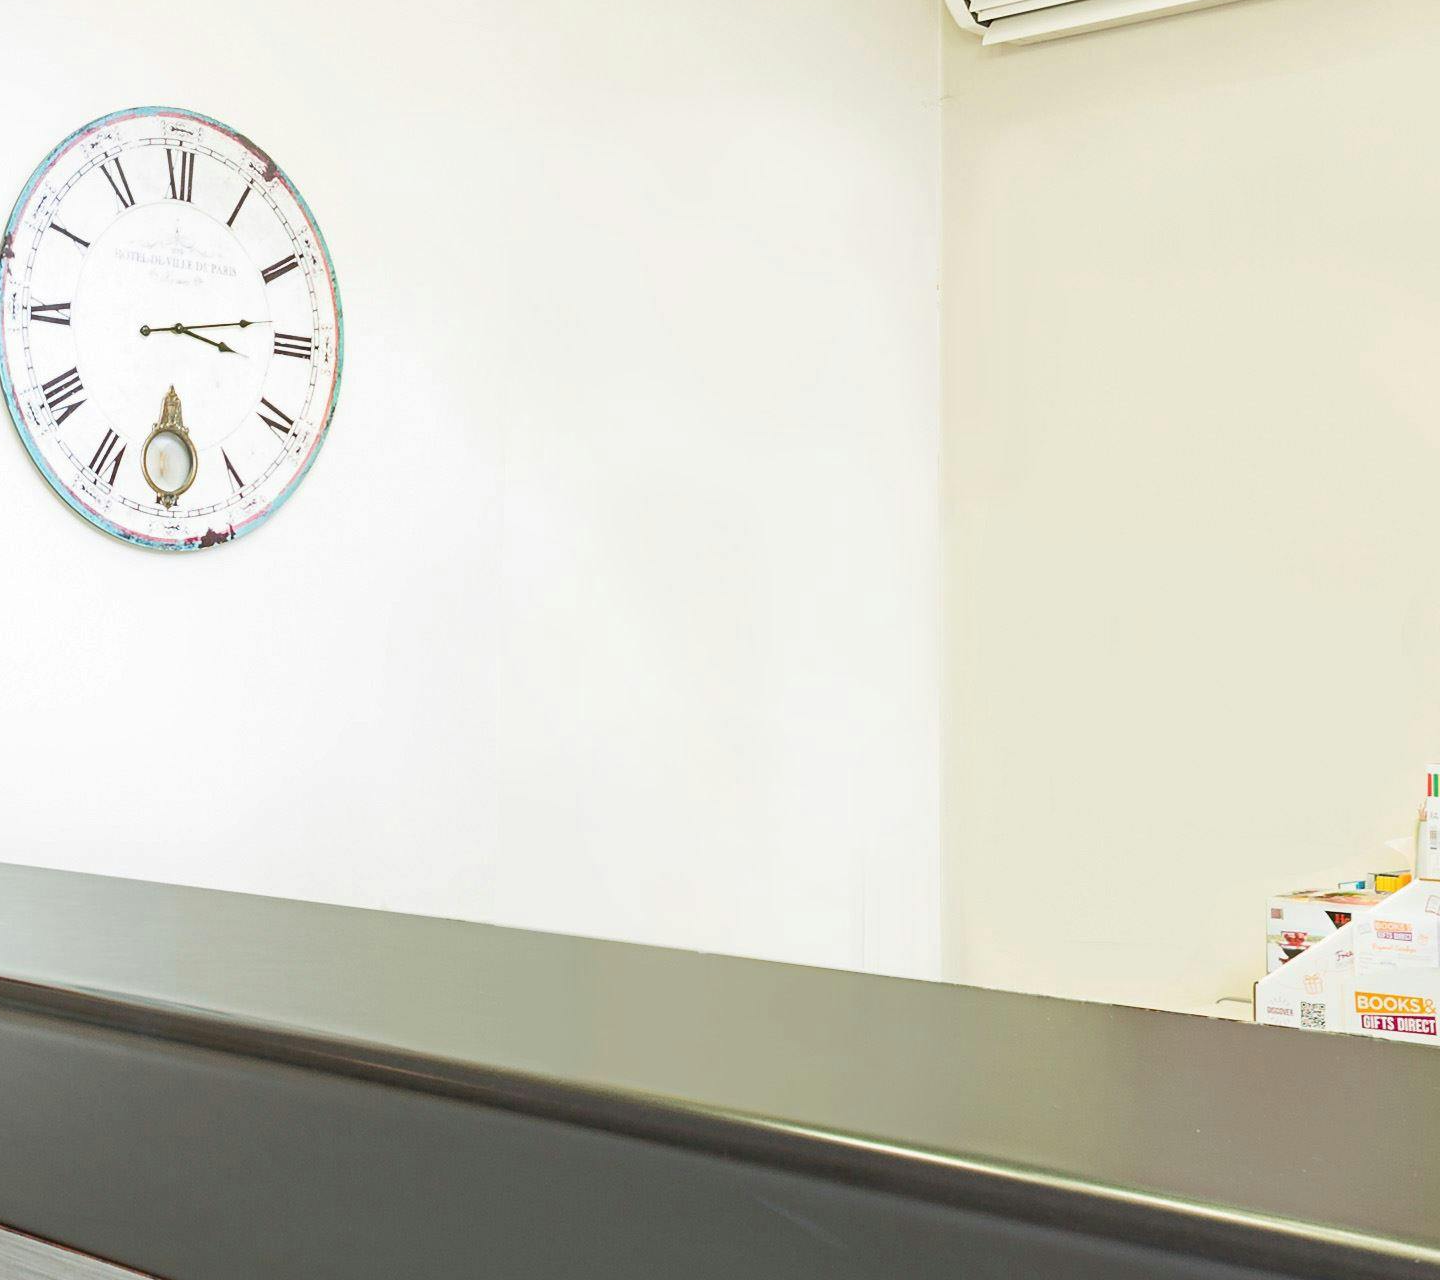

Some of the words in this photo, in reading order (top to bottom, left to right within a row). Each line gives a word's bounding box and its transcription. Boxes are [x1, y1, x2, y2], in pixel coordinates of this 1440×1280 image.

[1357, 995, 1420, 1012] BOOKS
[1423, 999, 1437, 1015] &
[1363, 1015, 1395, 1031] GIFTS
[1397, 1017, 1437, 1035] DIRECT
